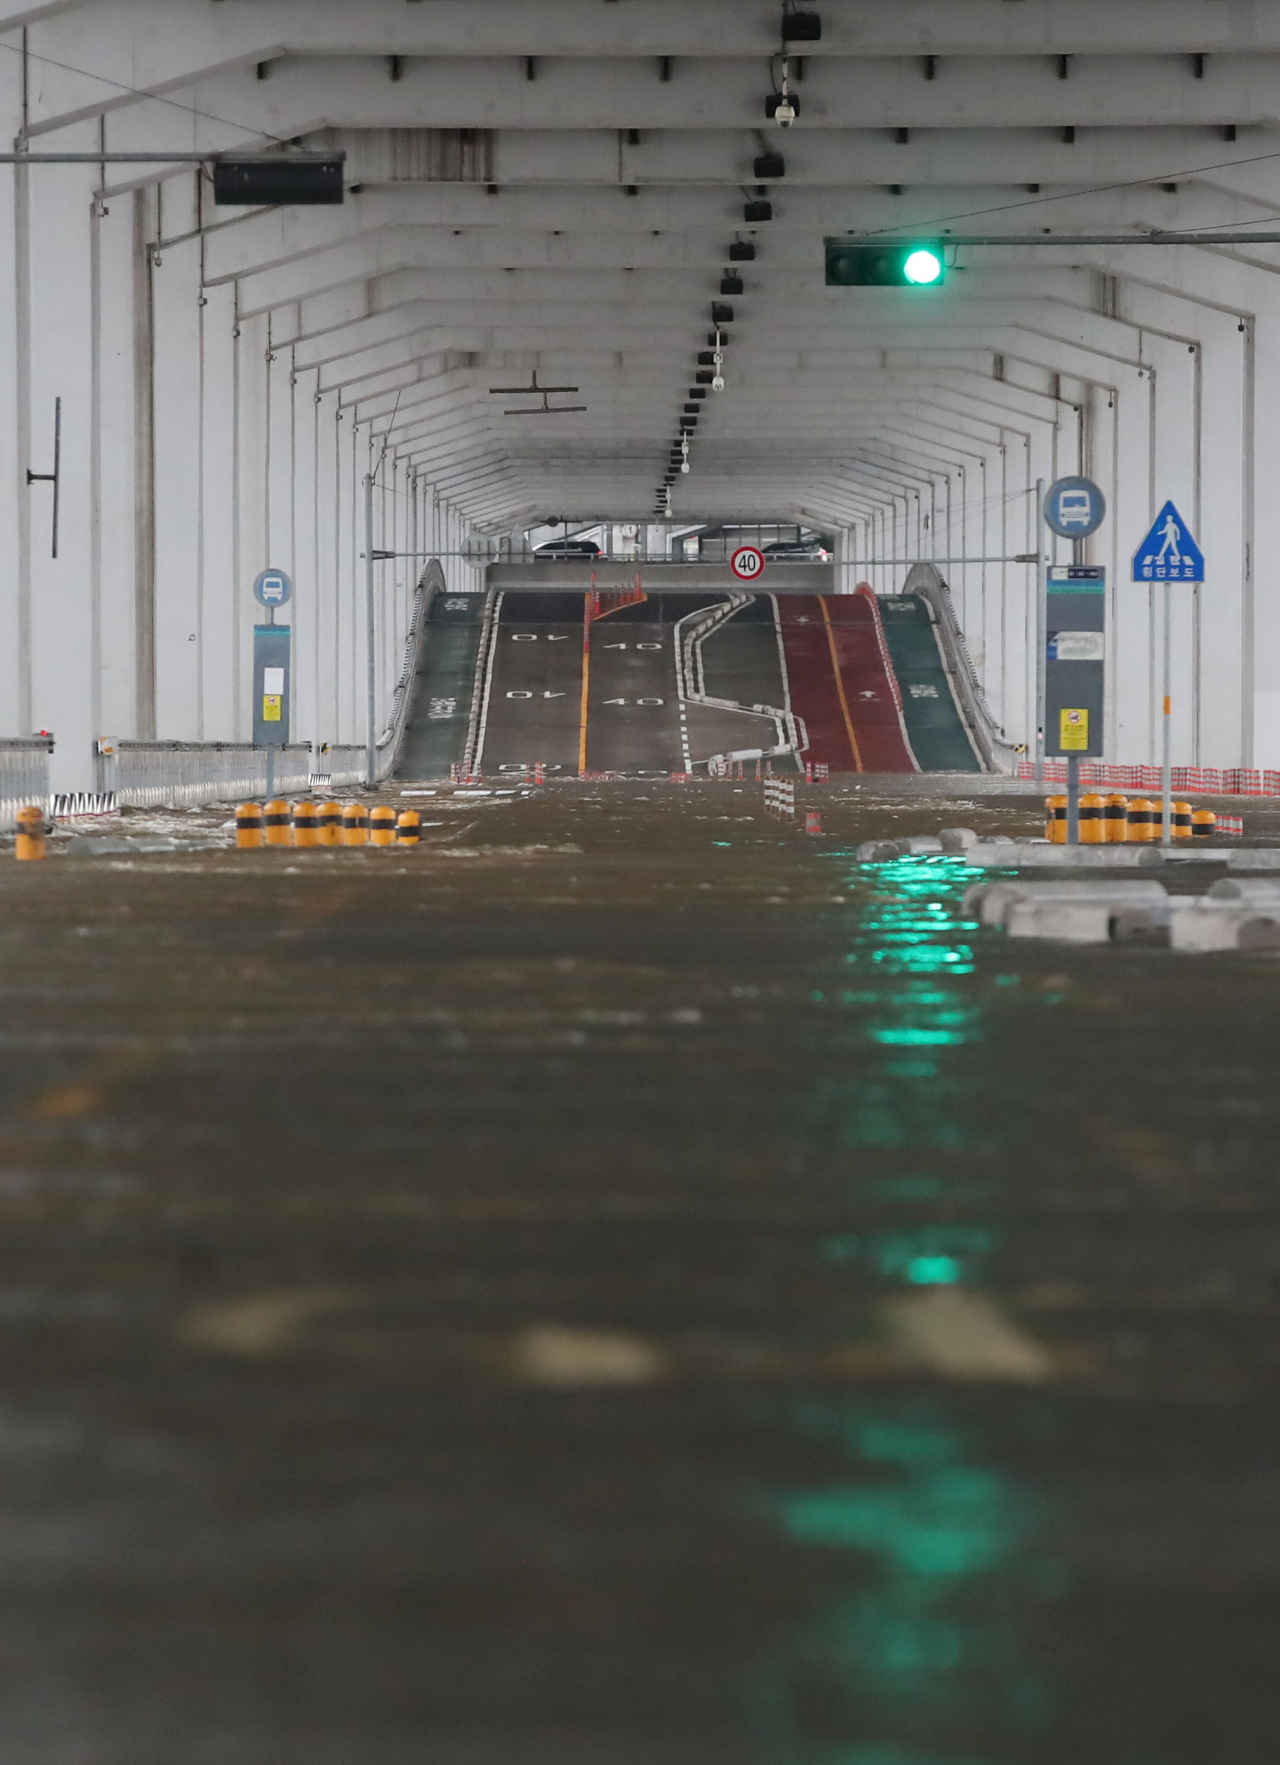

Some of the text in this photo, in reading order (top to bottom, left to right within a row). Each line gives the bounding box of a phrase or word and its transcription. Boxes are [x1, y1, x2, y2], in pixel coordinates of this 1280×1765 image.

[738, 554, 756, 572] 40
[1142, 566, 1195, 578] 횡단보도
[511, 633, 569, 641] 40
[506, 691, 567, 699] 40
